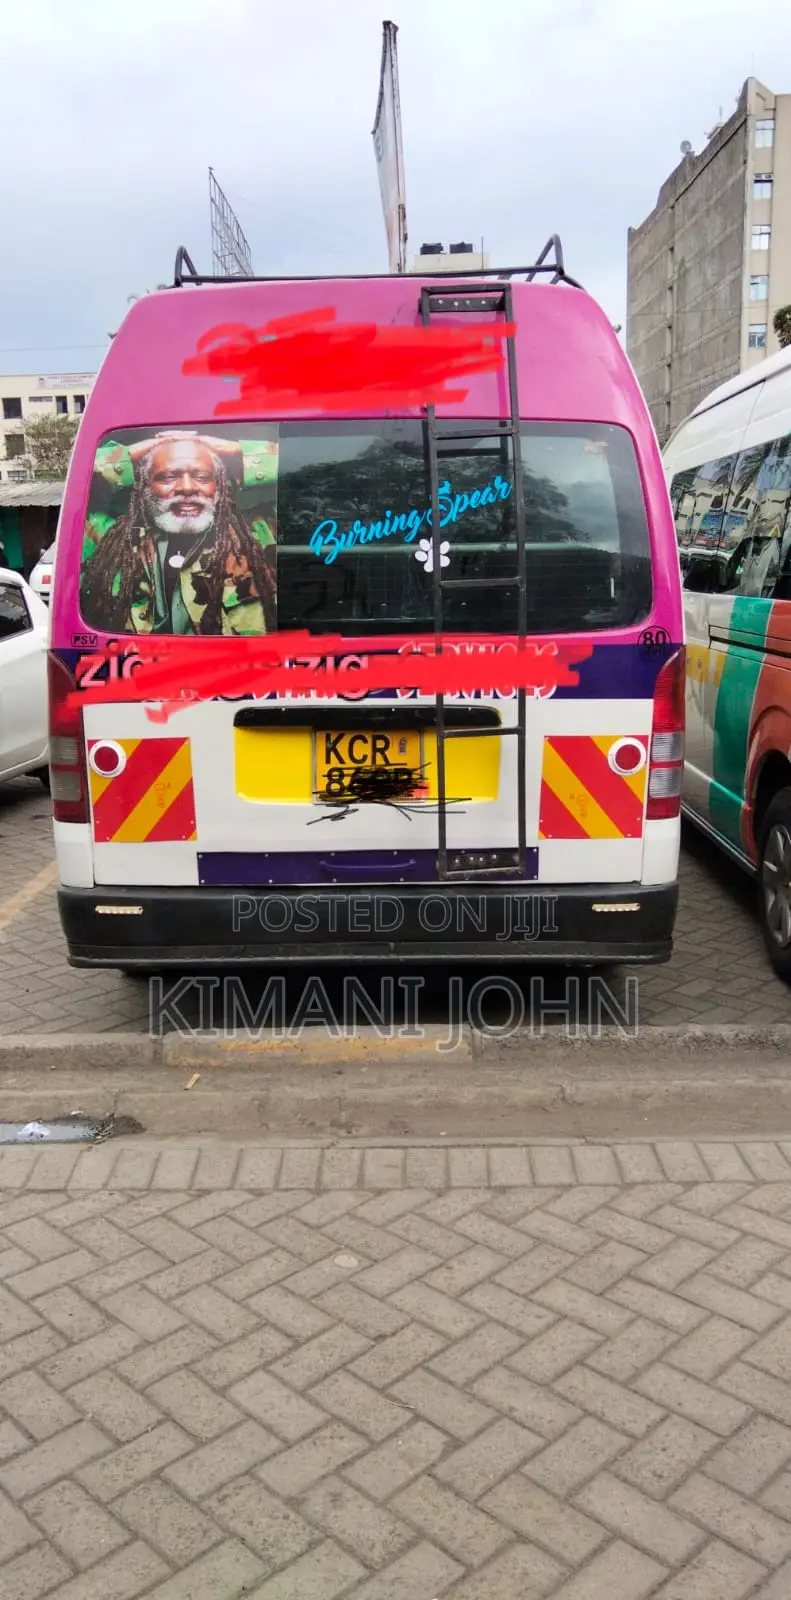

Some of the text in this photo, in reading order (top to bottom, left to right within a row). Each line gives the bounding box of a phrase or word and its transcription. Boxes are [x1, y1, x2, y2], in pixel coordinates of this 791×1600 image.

[309, 475, 512, 564] Burning Spear
[73, 635, 98, 645] PSV
[643, 631, 667, 648] 80
[325, 732, 391, 765] KCR
